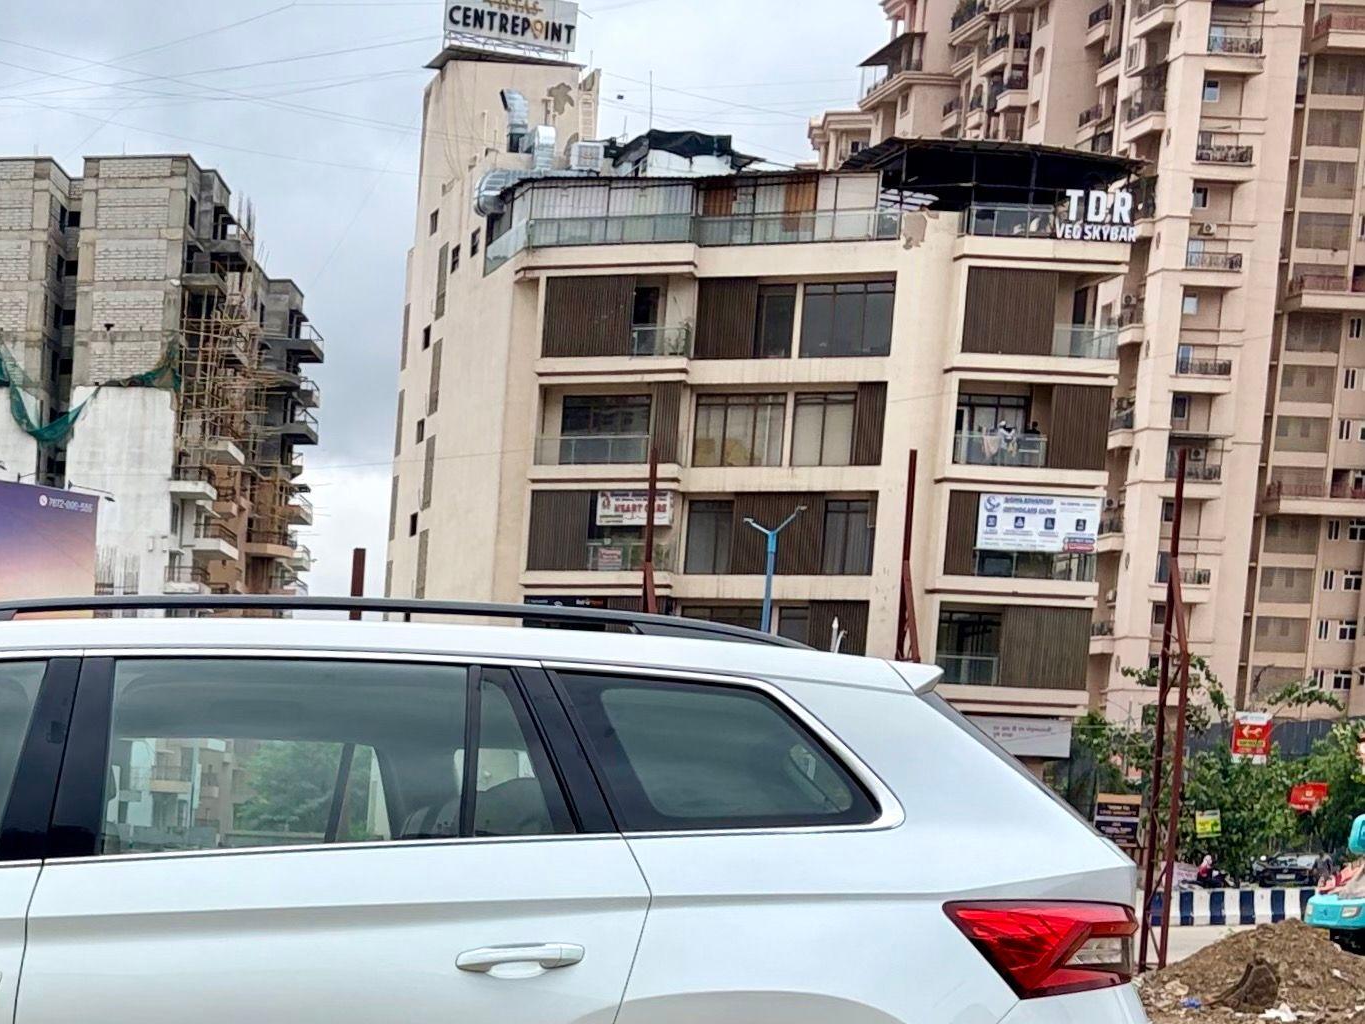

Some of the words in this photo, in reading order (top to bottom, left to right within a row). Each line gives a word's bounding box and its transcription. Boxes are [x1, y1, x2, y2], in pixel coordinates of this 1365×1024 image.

[448, 5, 576, 44] CENTREPOINT
[1065, 188, 1133, 224] TDR
[1055, 222, 1082, 240] VEG
[1083, 224, 1137, 243] SKYBAR
